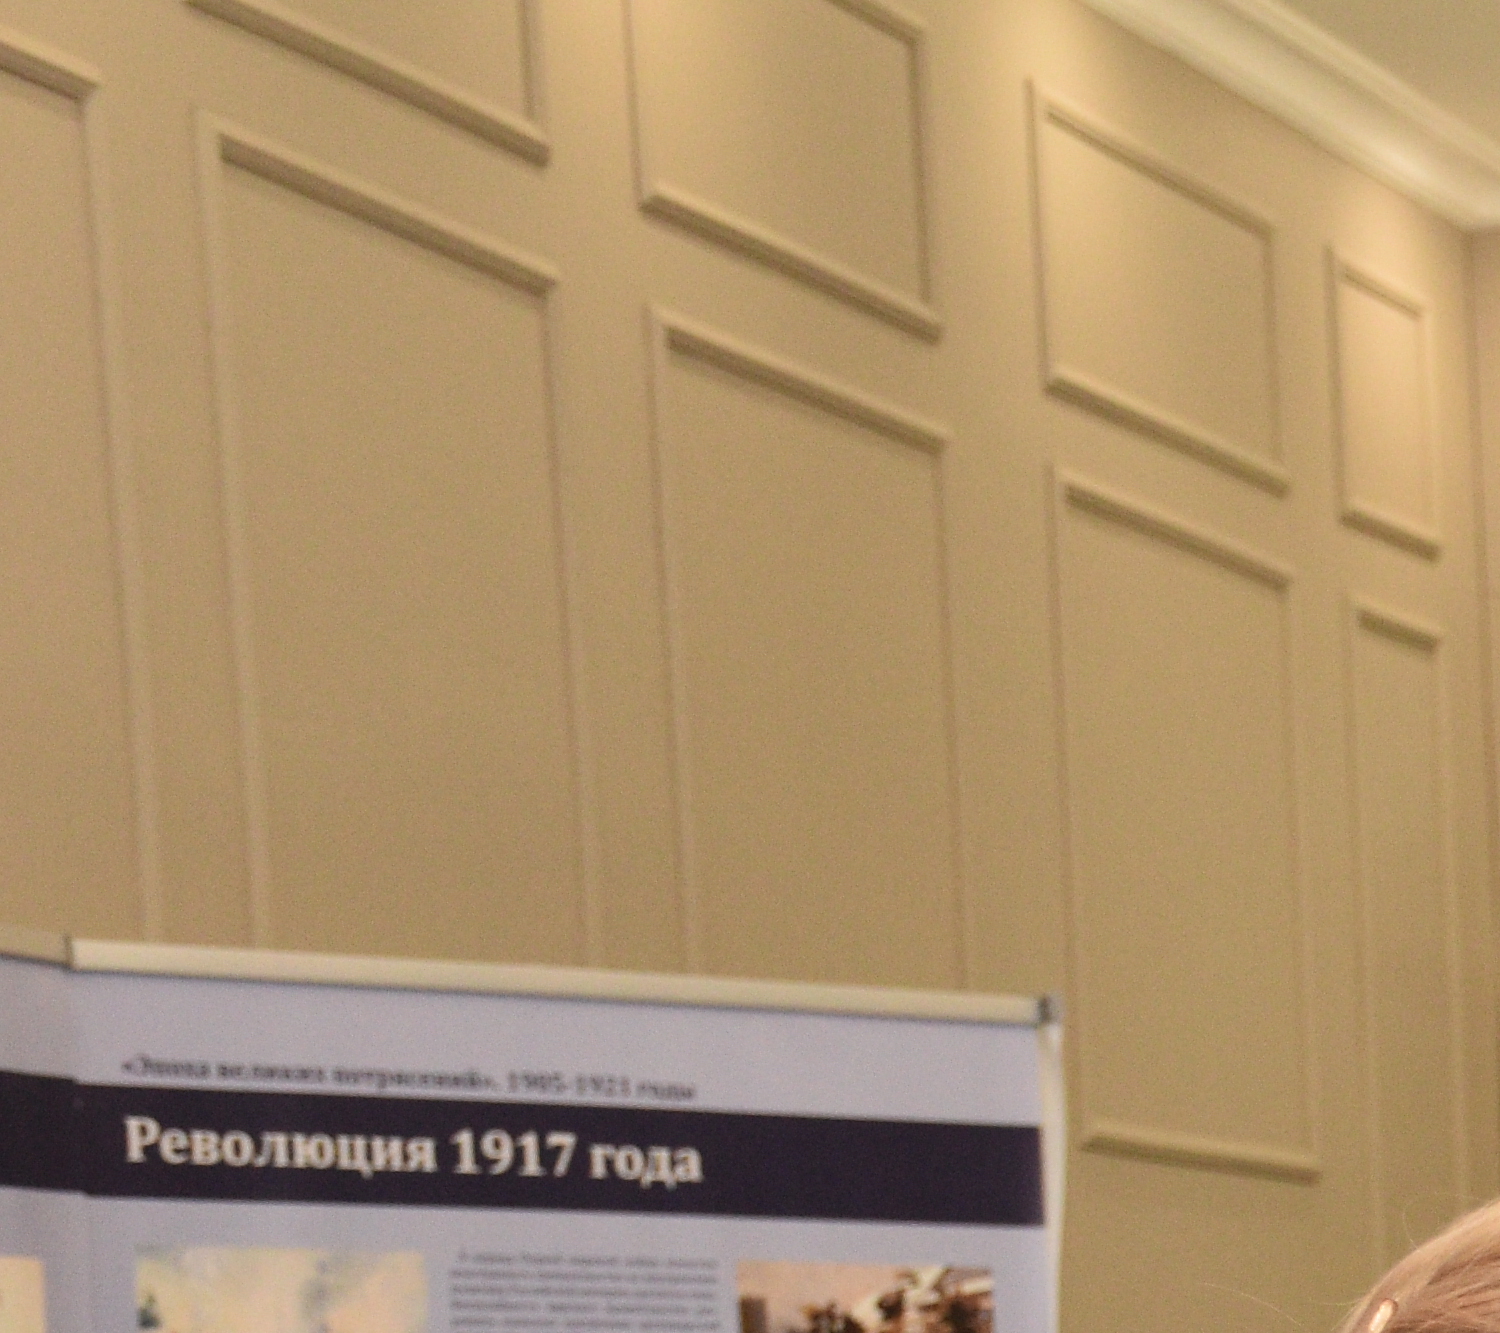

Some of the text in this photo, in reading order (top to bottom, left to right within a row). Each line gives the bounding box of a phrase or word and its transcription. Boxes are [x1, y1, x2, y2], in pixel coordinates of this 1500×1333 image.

[124, 1114, 704, 1191] Революция 1917 года
